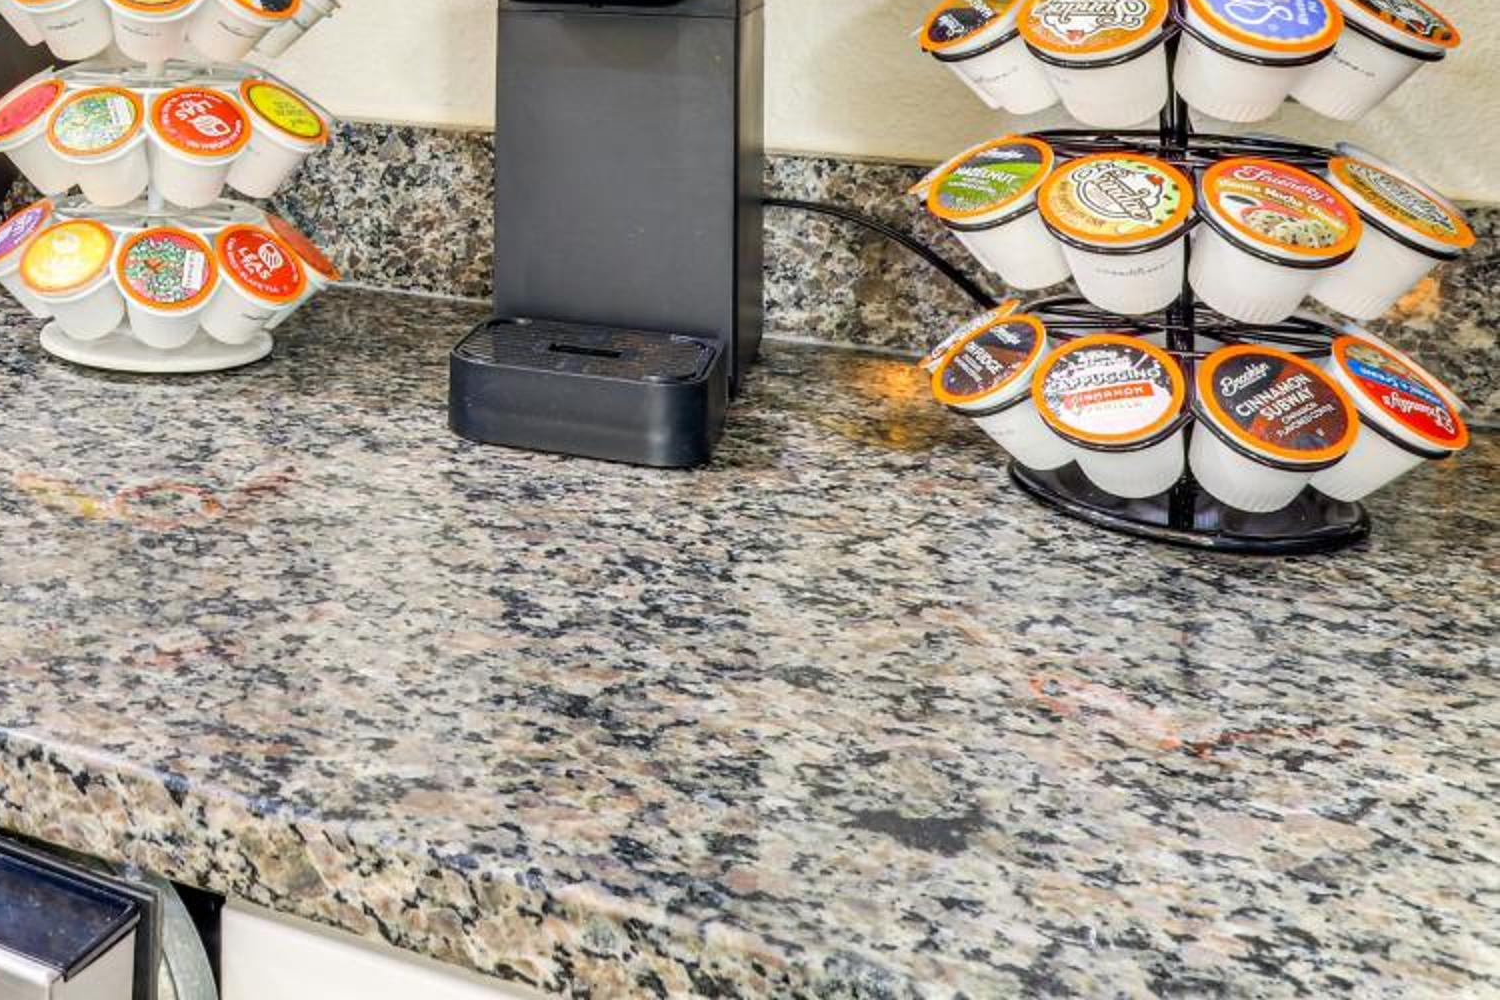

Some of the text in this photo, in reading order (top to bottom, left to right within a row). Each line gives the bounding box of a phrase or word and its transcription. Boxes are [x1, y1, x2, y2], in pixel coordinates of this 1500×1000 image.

[1233, 165, 1334, 205] Friendly's
[1235, 373, 1313, 418] CINNAMON
[1260, 386, 1316, 421] SUBWAY
